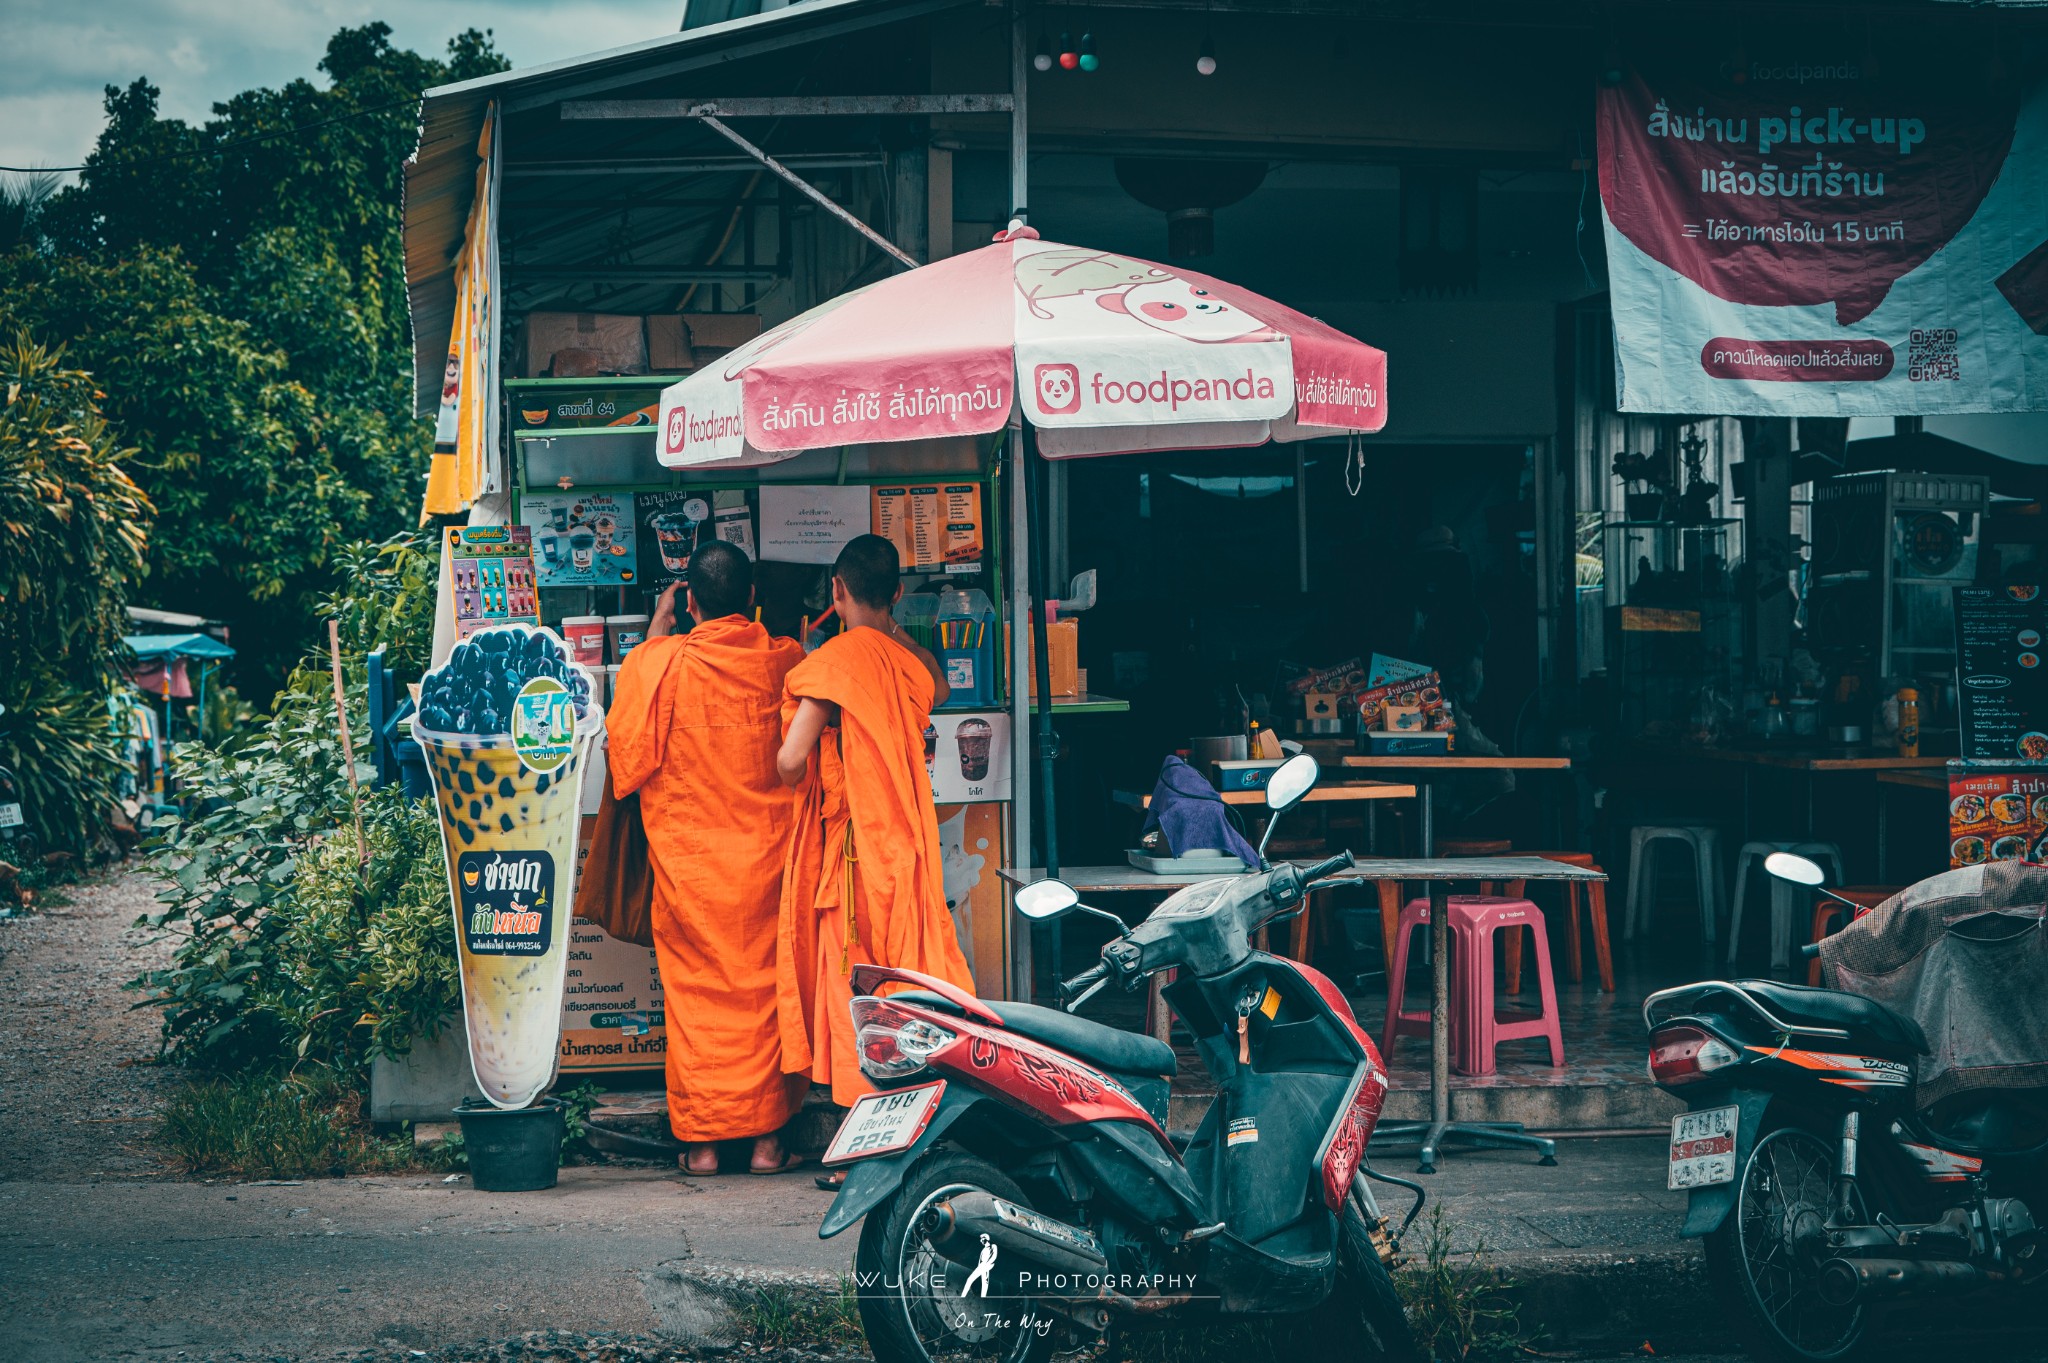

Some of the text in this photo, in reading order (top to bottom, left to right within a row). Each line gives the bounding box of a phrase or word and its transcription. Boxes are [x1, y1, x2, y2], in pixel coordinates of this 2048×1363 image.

[1752, 60, 1859, 84] foodpanda
[1647, 98, 1926, 154] สั่งผ่าน pick-up
[1701, 152, 1884, 197] แล้วรับที่ร้าน
[1706, 218, 1905, 243] ได้อาหารไวใน 15 นาที
[1713, 346, 1883, 368] ดาวน์โหลดแอปแล้วสั่งเลย
[1091, 368, 1275, 411] foodpanda
[558, 398, 615, 416] สาขาที่ 64
[762, 383, 1002, 431] สั่งกิน สั่งใช้ สั่งได้ทุกวัน
[2012, 779, 2048, 794] ลำปา
[485, 853, 541, 902] ชามุก
[1860, 1058, 1909, 1073] Dream
[859, 1112, 906, 1132] เชียงใหม่
[847, 1130, 896, 1153] 225
